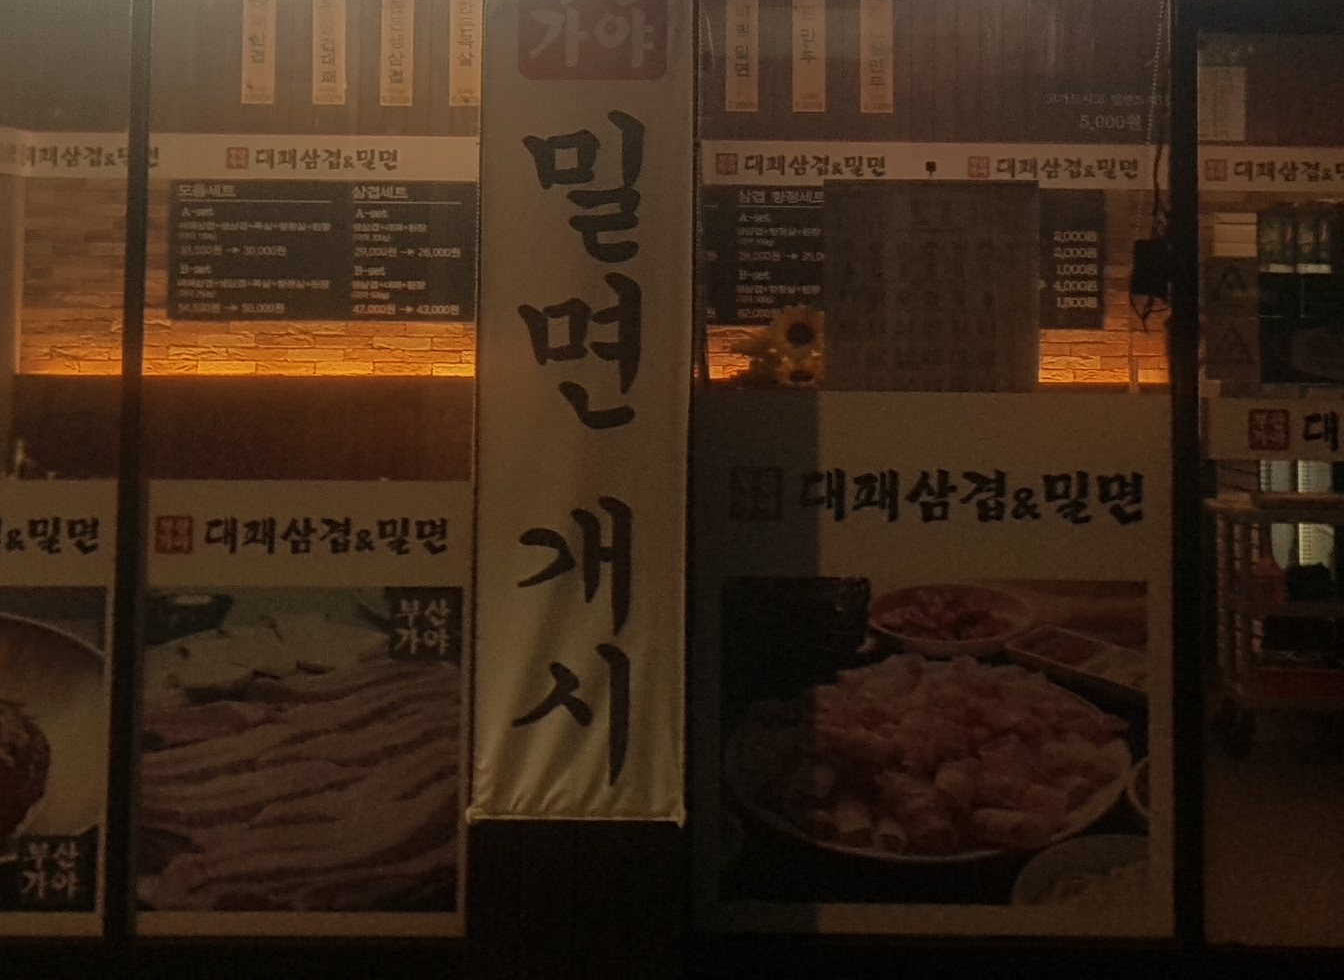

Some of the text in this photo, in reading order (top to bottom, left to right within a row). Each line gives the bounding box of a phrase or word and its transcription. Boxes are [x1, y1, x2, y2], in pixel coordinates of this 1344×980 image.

[529, 6, 655, 68] 가야
[511, 111, 644, 787] 밀면 개시
[800, 468, 1144, 525] 대패삼겹&밀면
[204, 516, 449, 556] 대패삼겹&밀면
[395, 598, 450, 626] 부산
[395, 628, 449, 656] 가야
[21, 870, 79, 899] 가야
